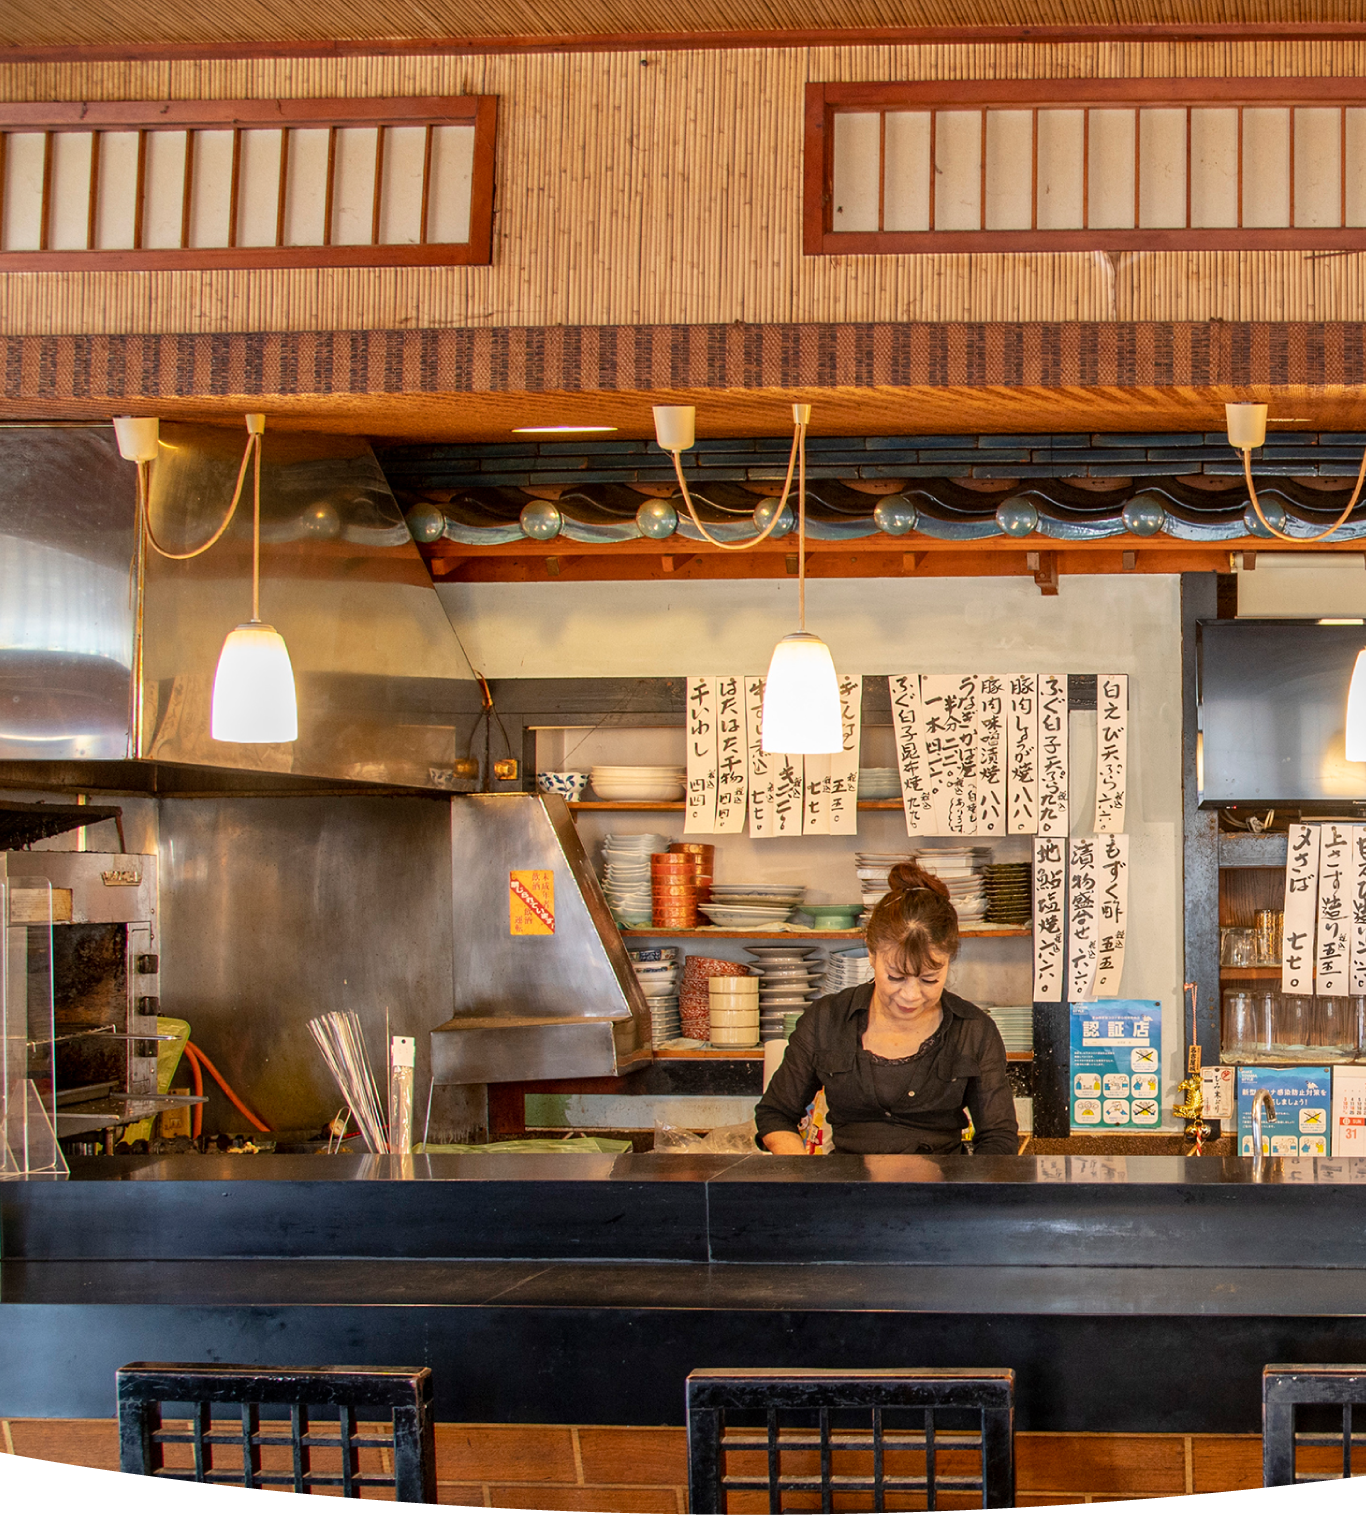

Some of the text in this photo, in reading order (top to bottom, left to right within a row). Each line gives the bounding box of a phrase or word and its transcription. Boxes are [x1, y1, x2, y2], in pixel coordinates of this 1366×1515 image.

[690, 683, 710, 757] 干いわし
[924, 696, 946, 733] 一本
[944, 694, 961, 732] 半分
[980, 678, 1003, 784] 豚肉味噌漬焼
[1010, 678, 1034, 783] 豚肉しょうが焼
[1099, 681, 1124, 790] 白えび天ぷら
[1036, 842, 1063, 934] 地鮎塩焼
[1071, 842, 1096, 940] 漬物盛合せ
[1102, 840, 1126, 923] もずく酢
[1083, 1021, 1149, 1037] 認証店
[1346, 1129, 1357, 1139] 31
